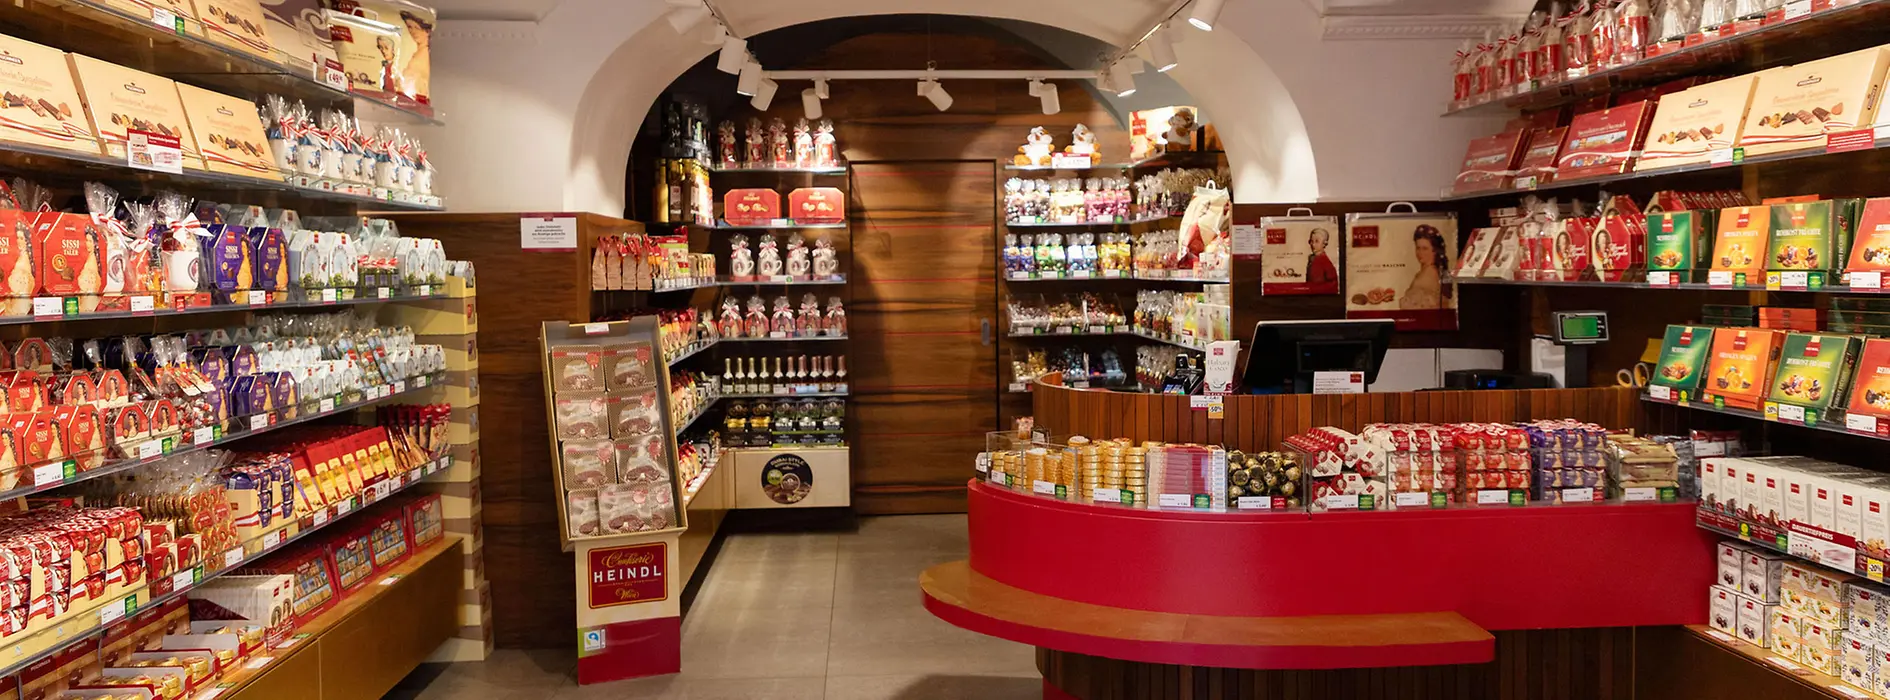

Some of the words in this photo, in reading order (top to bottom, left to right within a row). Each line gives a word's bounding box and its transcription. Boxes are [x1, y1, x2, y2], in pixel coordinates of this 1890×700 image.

[62, 239, 80, 249] SISSI
[1791, 523, 1834, 541] DAUERTIEFPREIS
[593, 565, 662, 583] HEINDL
